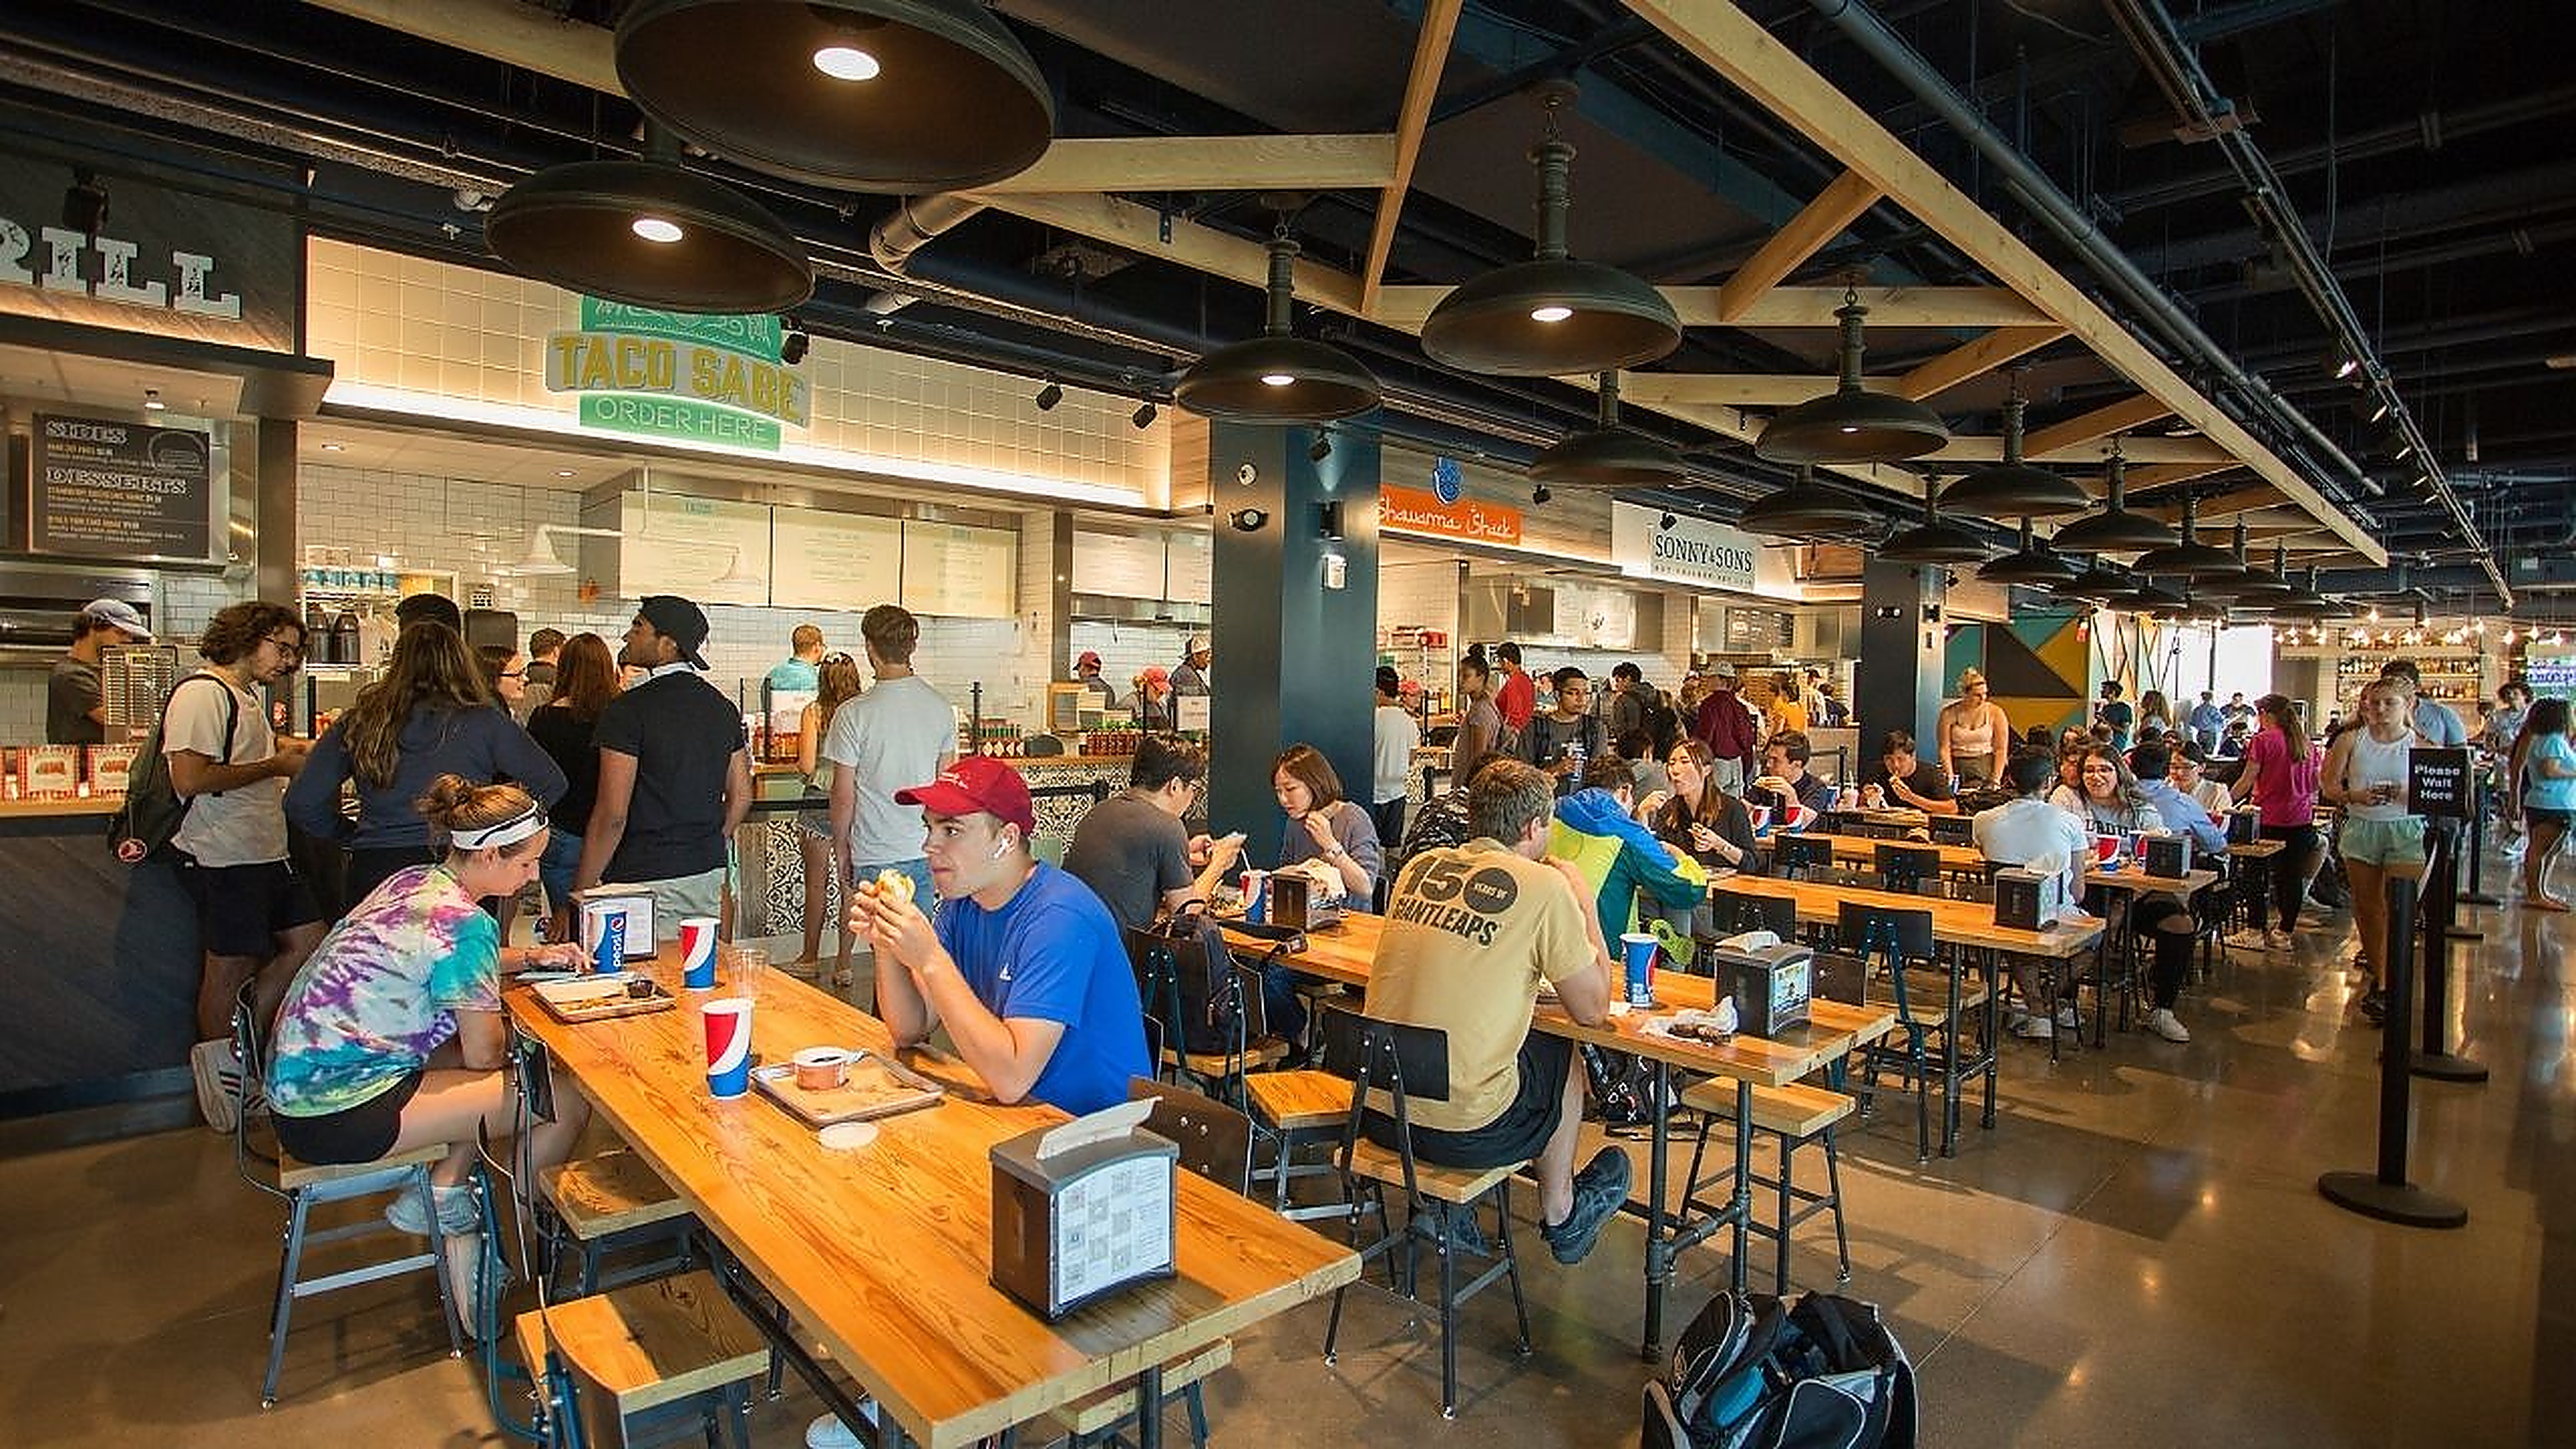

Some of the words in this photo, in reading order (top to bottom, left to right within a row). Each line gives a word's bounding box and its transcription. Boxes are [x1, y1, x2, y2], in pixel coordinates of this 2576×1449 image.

[556, 337, 676, 389] TACO
[692, 346, 804, 421] SABE
[595, 396, 692, 433] ORDER
[699, 413, 767, 440] HERE
[46, 421, 128, 444] SIDES
[46, 466, 187, 494] DESSERTS
[2415, 764, 2460, 775] Please
[2420, 790, 2453, 800] Here
[2422, 777, 2452, 788] Wait
[611, 932, 623, 967] pepsi
